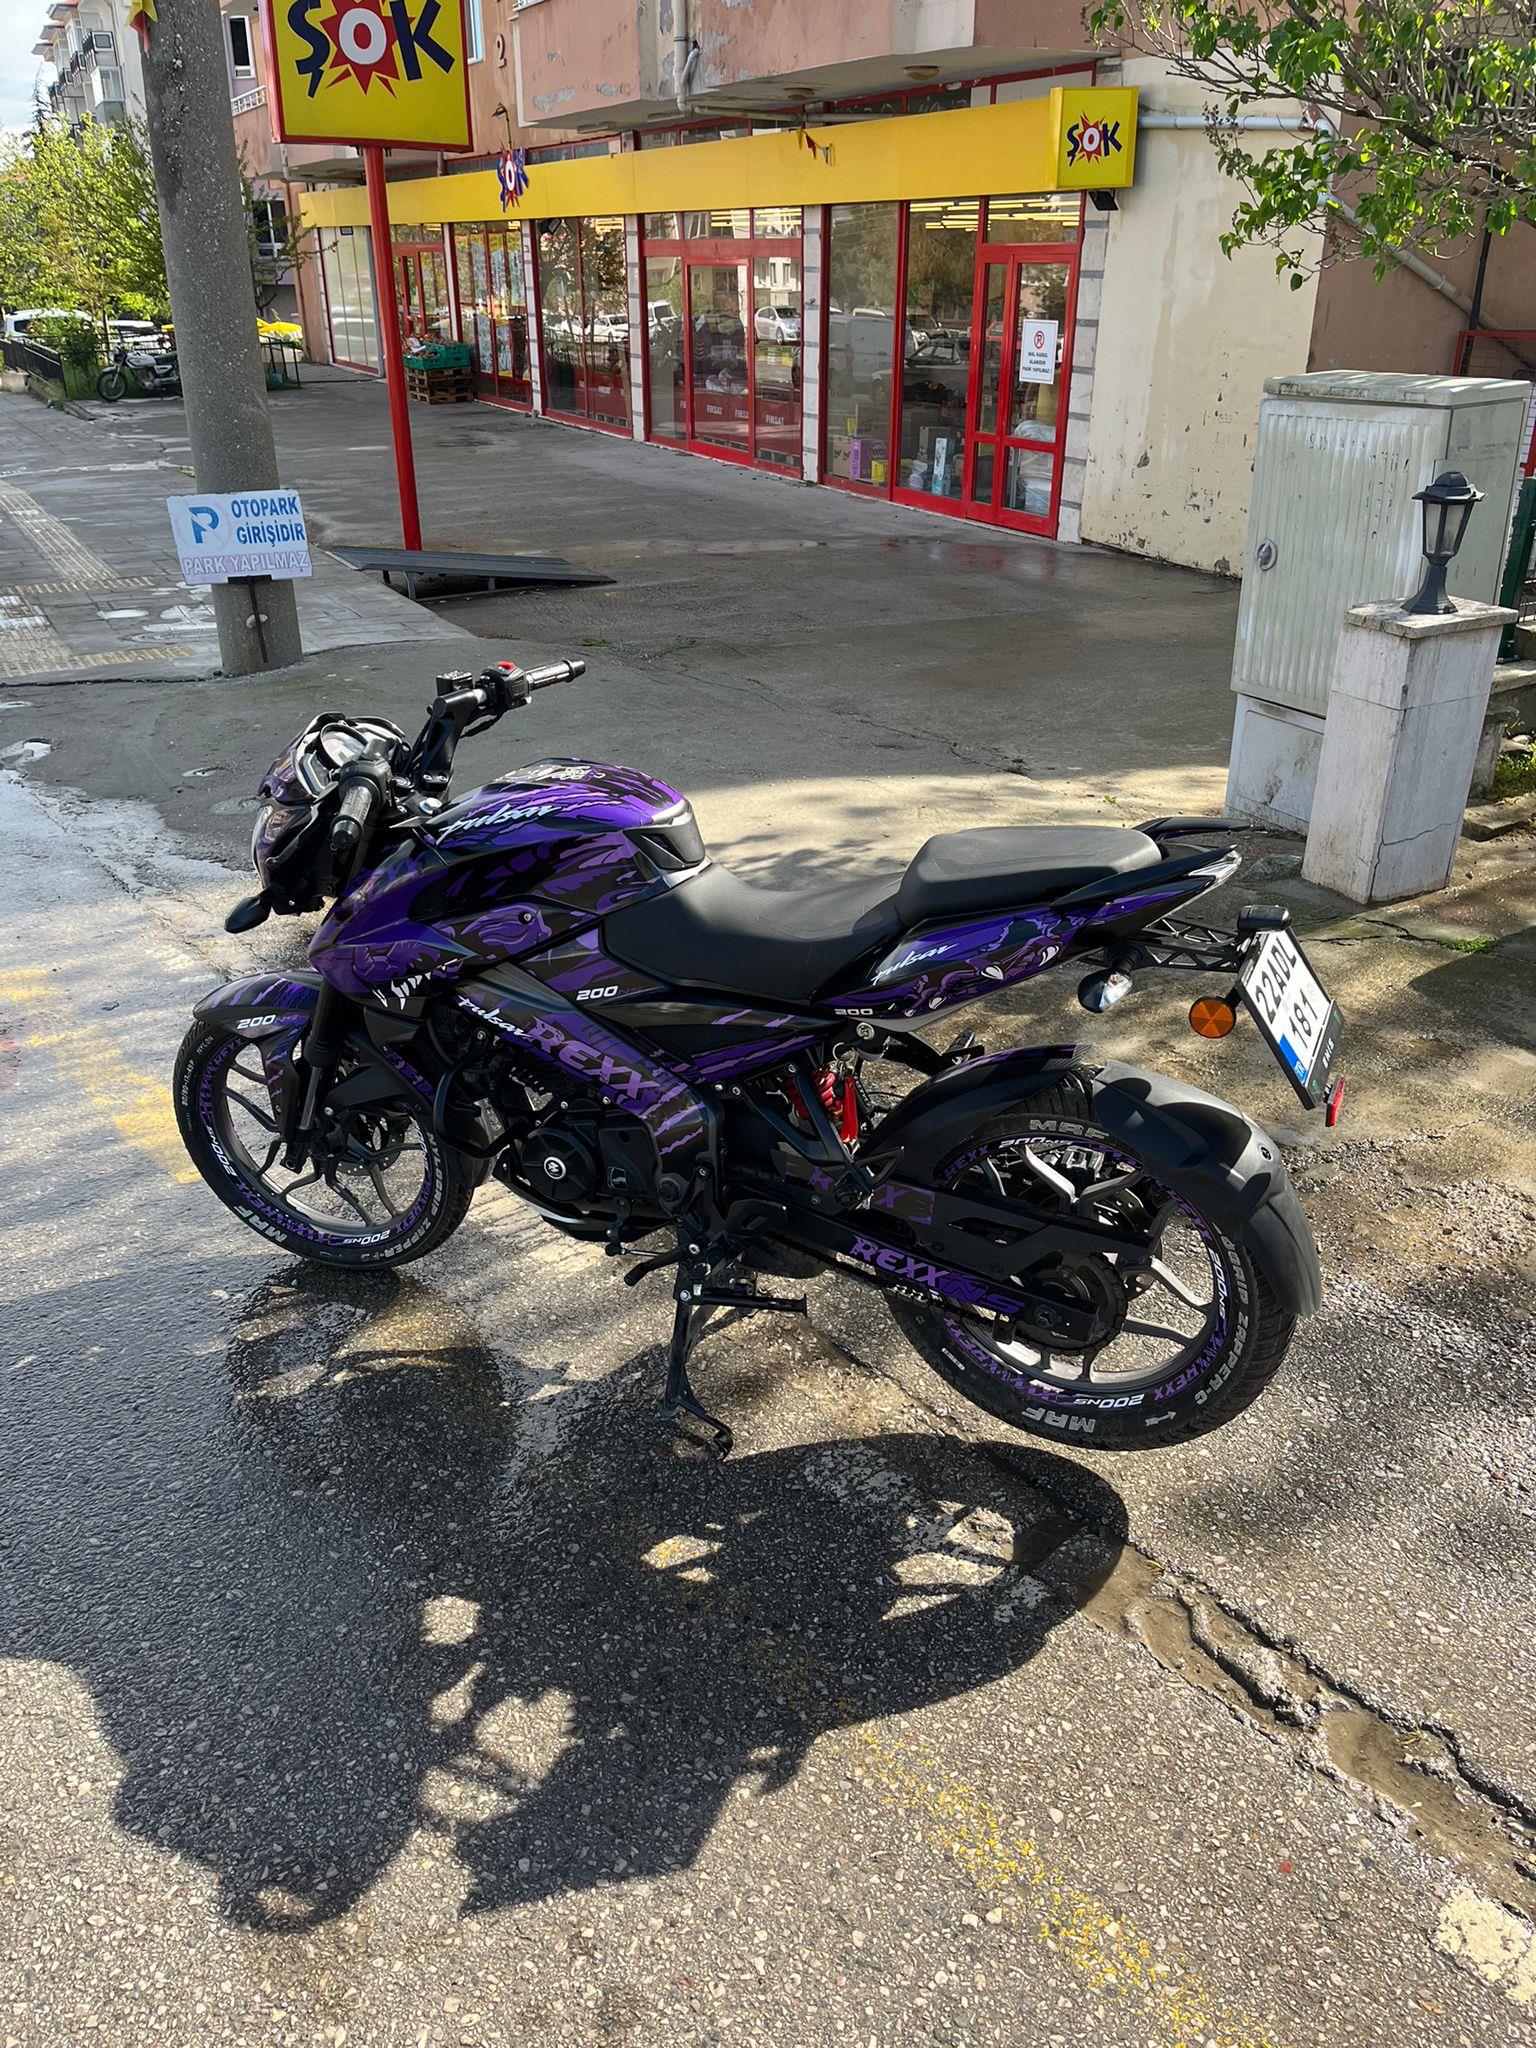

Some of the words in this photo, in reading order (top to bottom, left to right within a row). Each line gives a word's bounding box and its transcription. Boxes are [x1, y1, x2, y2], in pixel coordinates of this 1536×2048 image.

[286, 0, 456, 99] ŞOK
[1066, 120, 1123, 167] ŞOK
[706, 404, 723, 416] FIRSAT
[765, 414, 785, 427] FIRSAT
[231, 496, 299, 519] OTOPARK
[236, 519, 305, 548] GİRİŞİDİR
[182, 556, 227, 576] PARK
[229, 551, 309, 573] YAPILMAZ
[1288, 988, 1318, 1049] 181
[531, 1015, 661, 1100] REXX
[998, 1136, 1074, 1150] 200NS
[1029, 1119, 1110, 1140] MRF
[206, 1126, 238, 1177] 200NS
[426, 1132, 444, 1217] NYLOGRIP
[234, 1205, 288, 1243] MRF
[343, 1229, 391, 1245] 200NS
[1207, 1247, 1228, 1319] 200NS
[1194, 1311, 1249, 1405] ZAPPER-C
[1153, 1366, 1200, 1401] REXX
[1073, 1393, 1145, 1409] 200NS
[1021, 1407, 1097, 1434] MRF
